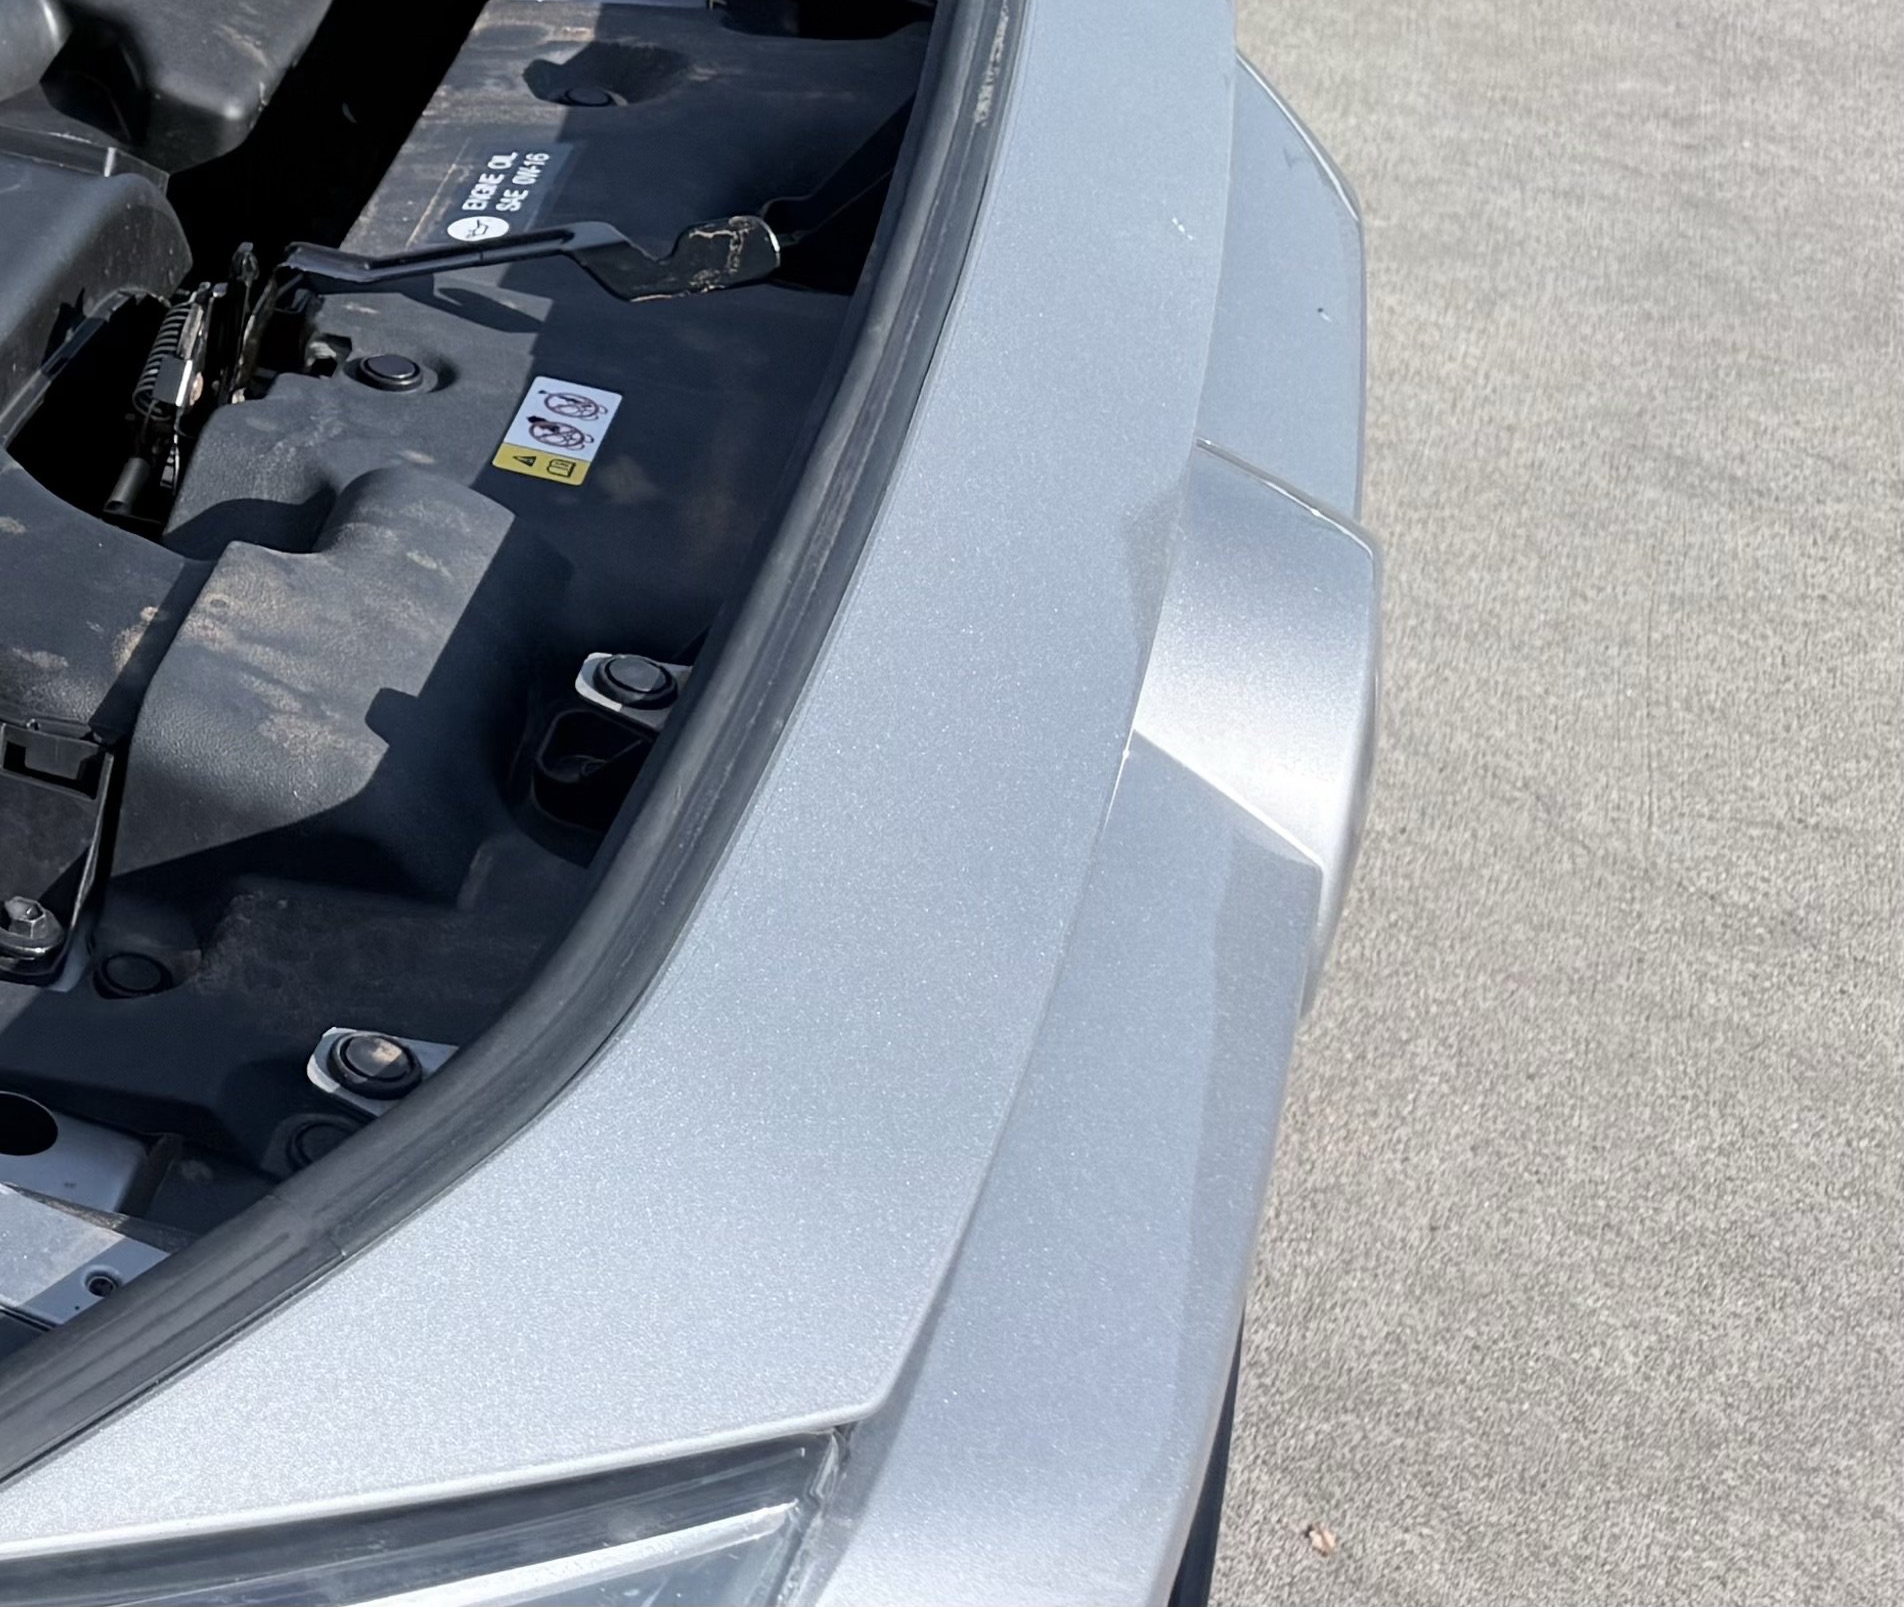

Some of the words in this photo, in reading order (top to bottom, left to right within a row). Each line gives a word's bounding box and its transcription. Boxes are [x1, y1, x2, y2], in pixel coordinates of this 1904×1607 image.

[461, 173, 505, 211] ENGINE
[487, 151, 518, 170] OIL
[495, 189, 529, 212] SAE
